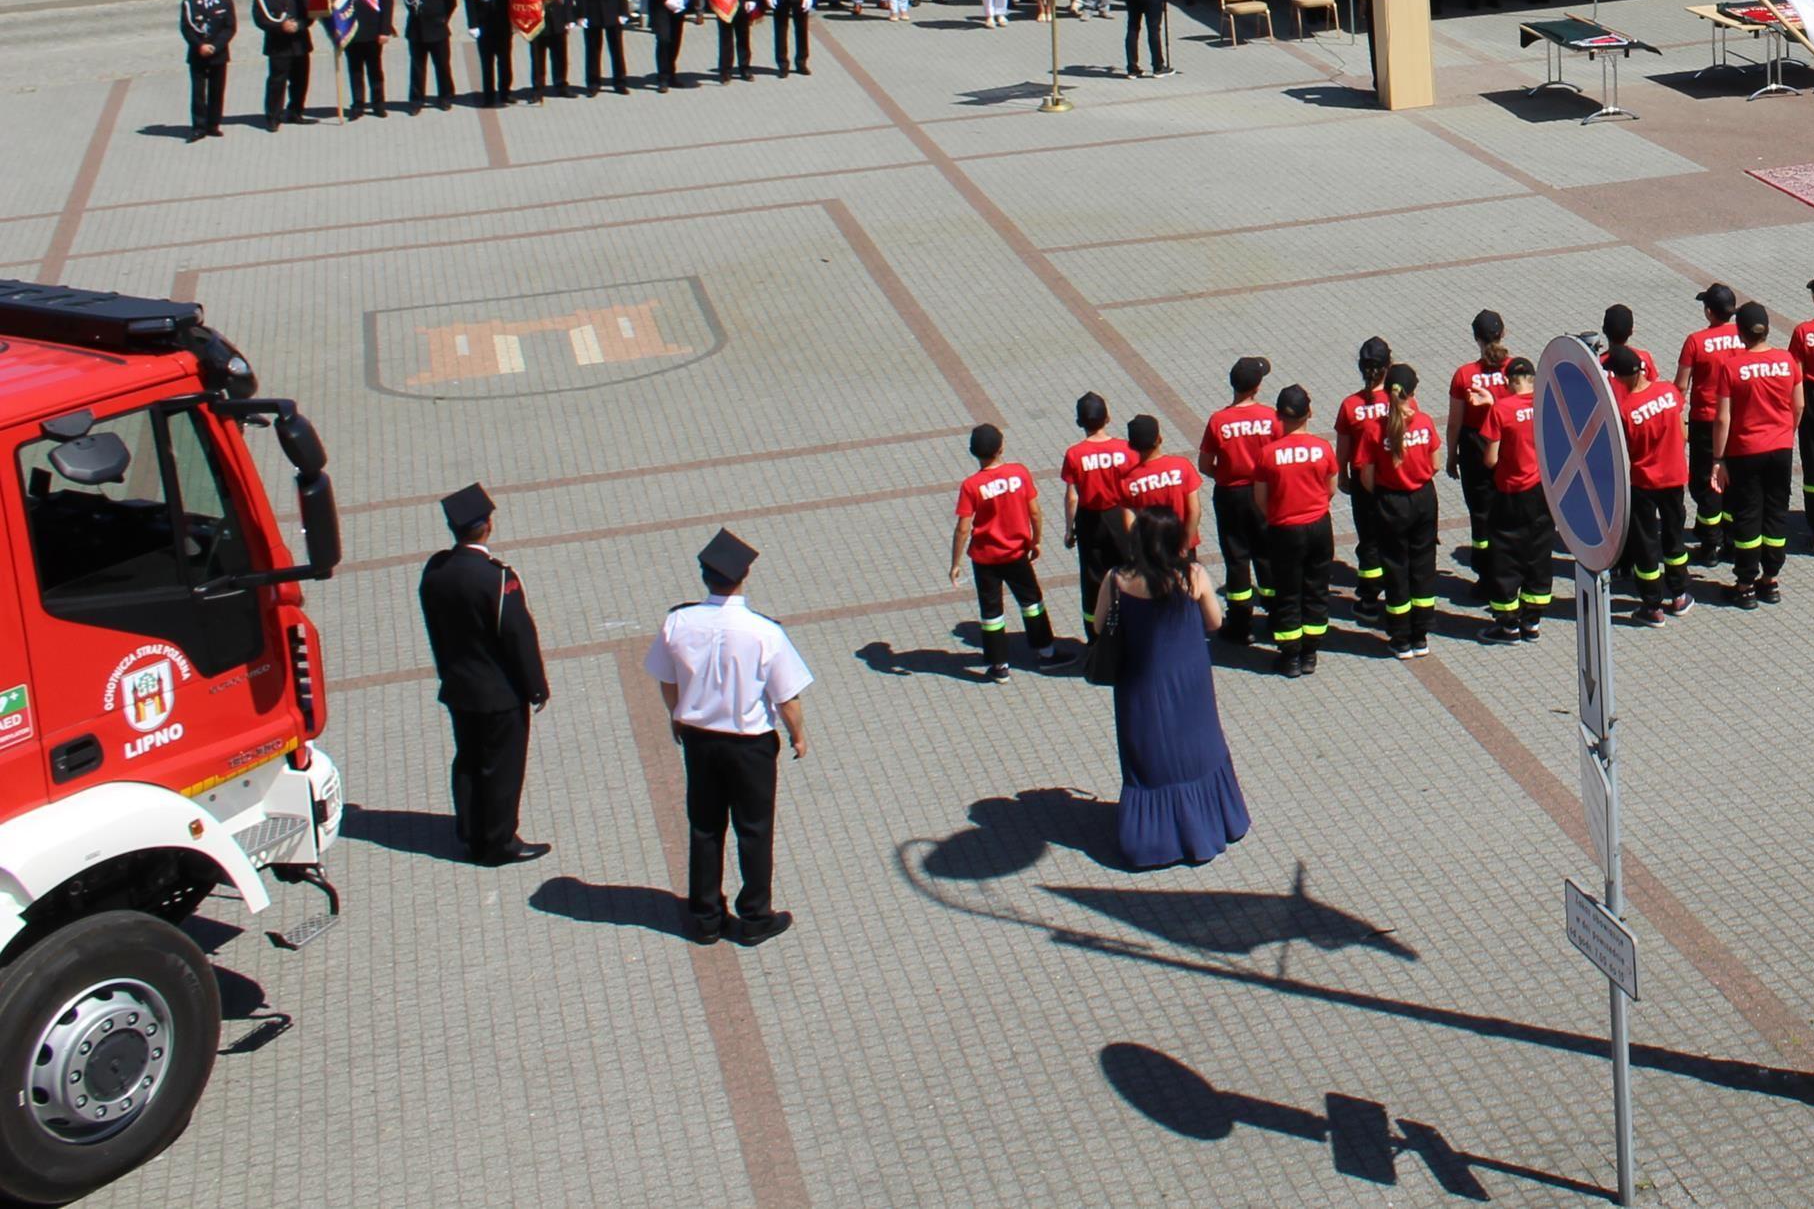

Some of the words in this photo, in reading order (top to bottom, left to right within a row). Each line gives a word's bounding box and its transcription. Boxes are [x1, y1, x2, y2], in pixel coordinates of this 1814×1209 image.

[1703, 334, 1746, 353] STRA
[1081, 450, 1126, 471] MDP
[1275, 446, 1323, 465] MDP
[978, 475, 1022, 501] MDP
[103, 653, 137, 711] OCHOTNICZA
[124, 722, 184, 759] LIPNO
